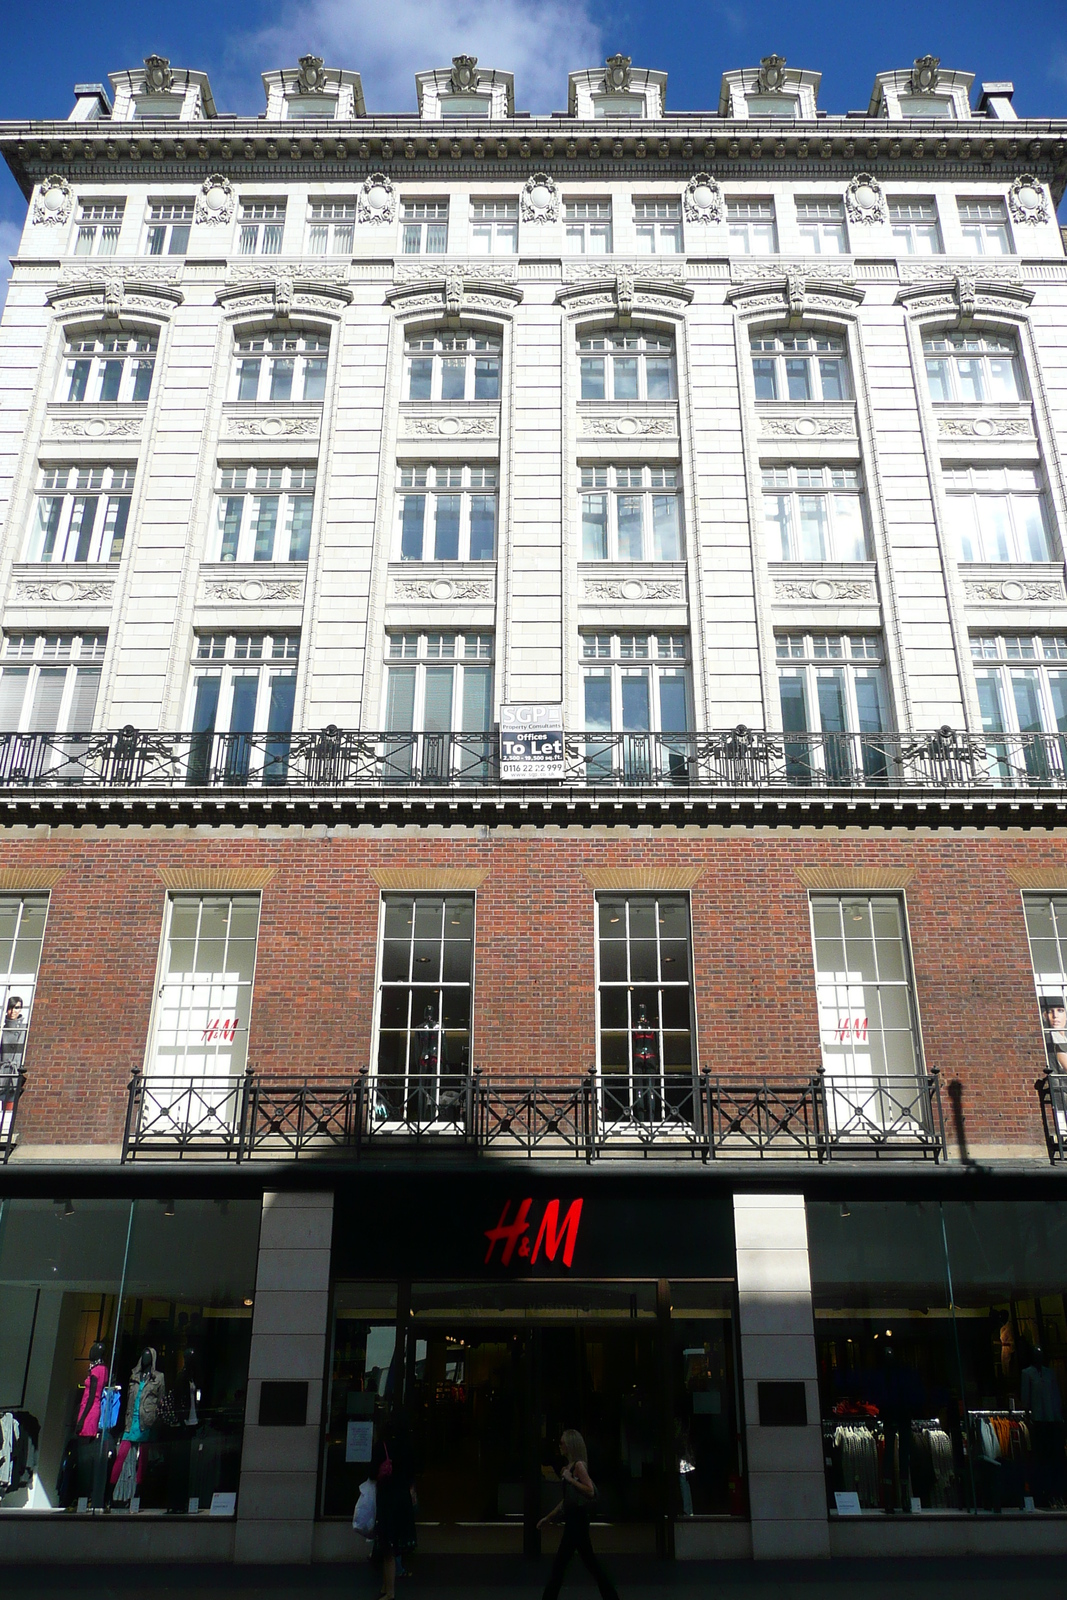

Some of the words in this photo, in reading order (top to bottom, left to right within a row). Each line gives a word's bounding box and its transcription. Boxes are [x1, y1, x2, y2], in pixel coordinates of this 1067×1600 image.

[503, 706, 546, 723] SGP
[517, 733, 547, 741] Offices
[503, 741, 525, 755] To
[531, 740, 562, 755] Let
[503, 764, 521, 772] 0116
[547, 763, 562, 772] 999
[201, 1018, 239, 1042] H&M
[484, 1198, 583, 1268] H&M
